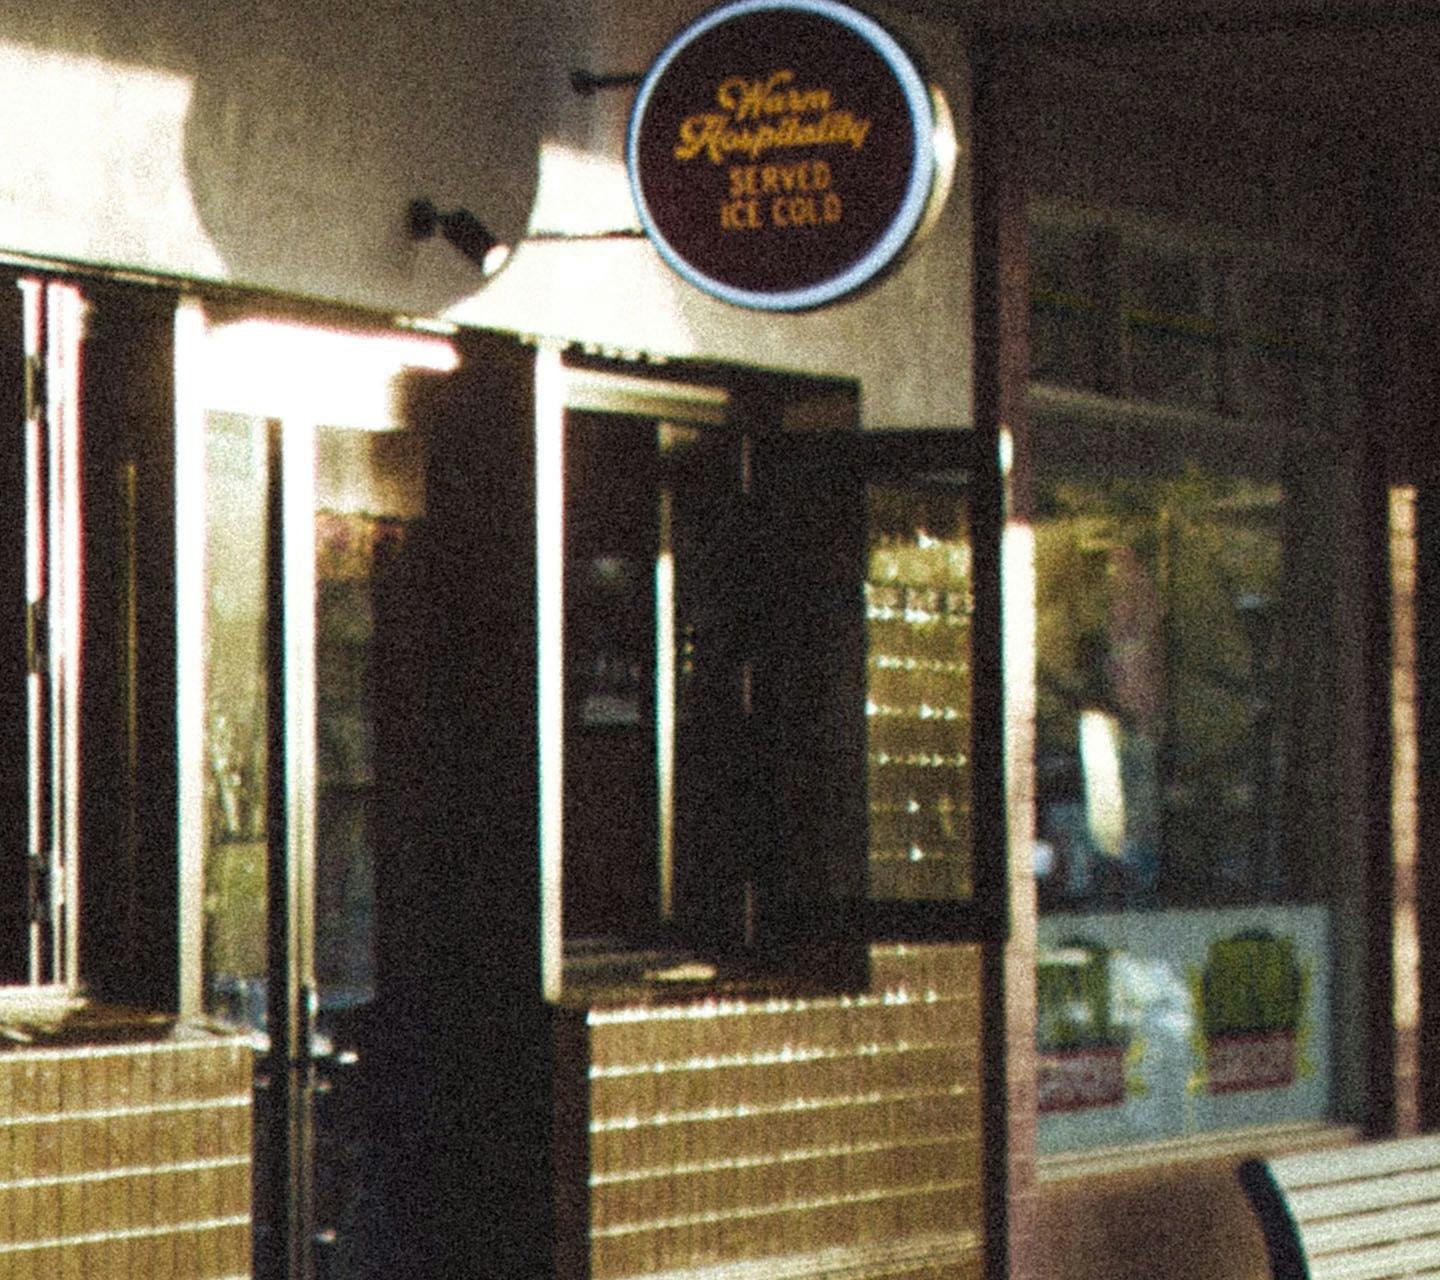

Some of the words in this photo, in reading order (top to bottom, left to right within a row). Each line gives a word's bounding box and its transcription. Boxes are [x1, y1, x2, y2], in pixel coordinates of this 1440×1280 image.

[718, 70, 831, 120] Warm
[675, 111, 871, 164] Hospitality
[730, 161, 831, 197] SERVED
[721, 199, 761, 229] ICE
[773, 192, 842, 227] COLD
